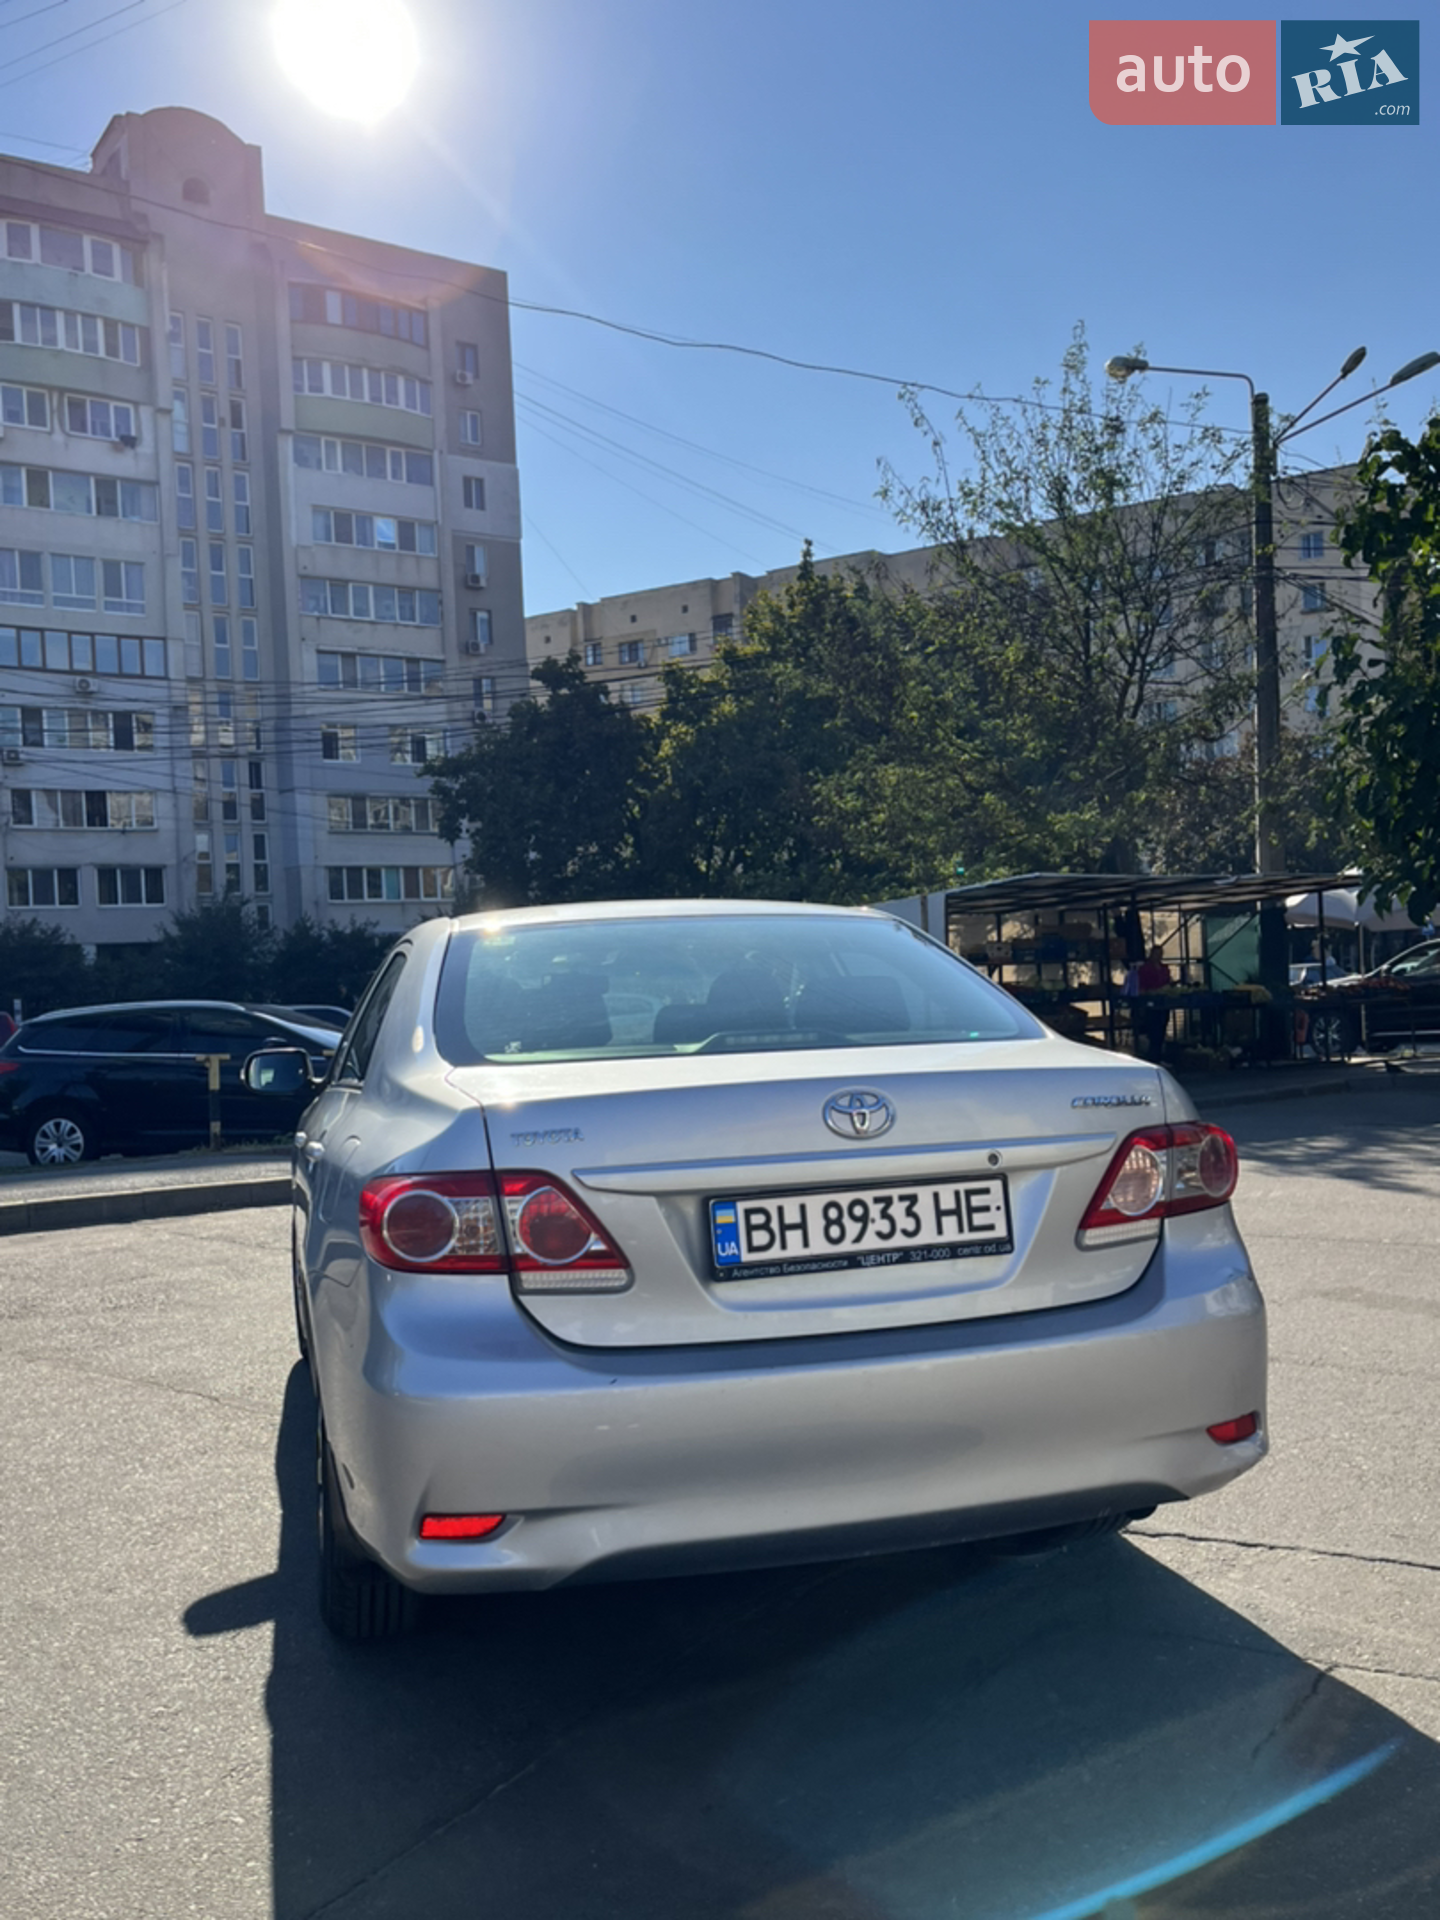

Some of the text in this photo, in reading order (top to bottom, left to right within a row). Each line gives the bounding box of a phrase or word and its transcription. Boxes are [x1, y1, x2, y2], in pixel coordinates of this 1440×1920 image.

[509, 1127, 585, 1148] TOYOTA
[743, 1186, 997, 1254] BH 8933 HE
[717, 1241, 740, 1257] UA
[731, 1265, 781, 1279] Агентство
[909, 1247, 950, 1262] 321-000
